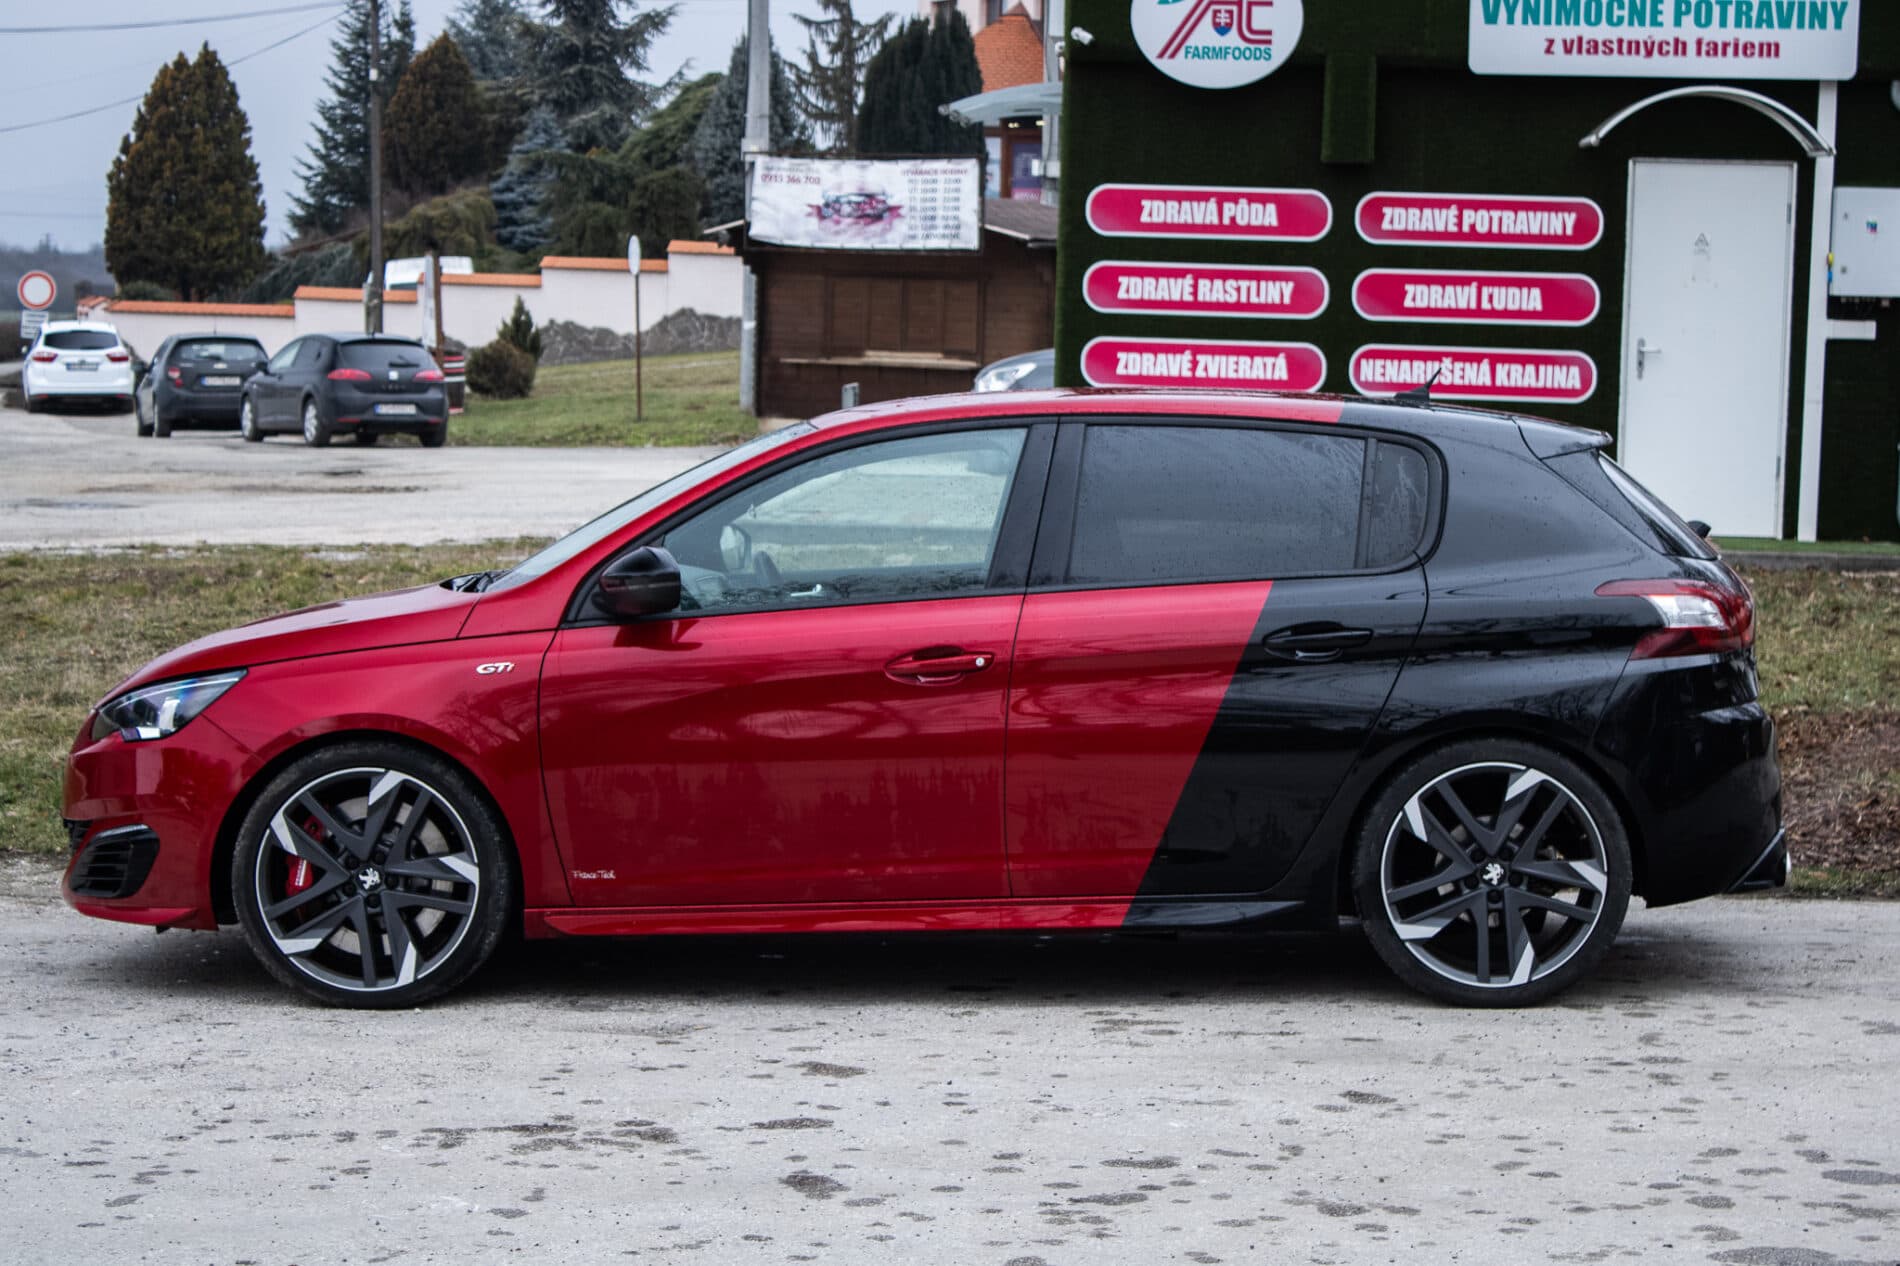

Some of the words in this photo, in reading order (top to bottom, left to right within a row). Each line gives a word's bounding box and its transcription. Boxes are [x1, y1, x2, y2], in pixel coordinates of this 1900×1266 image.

[1673, 0, 1848, 30] POTRAVINY
[1184, 45, 1273, 61] FARMFOODS
[1543, 38, 1555, 55] z
[1561, 35, 1687, 58] vlastných
[1695, 37, 1781, 59] fariem
[1140, 197, 1218, 225] ZDRAVÁ
[1222, 198, 1279, 227] PÔDA
[1381, 204, 1458, 232] ZDRAVÉ
[1462, 209, 1577, 237] POTRAVINY
[1117, 274, 1193, 302] ZDRAVÉ
[1197, 278, 1294, 305] RASTLINY
[1403, 281, 1478, 309] ZDRAVÍ
[1481, 285, 1543, 311] ĽUDIA
[1116, 350, 1192, 377] ZDRAVÉ
[1195, 352, 1288, 381] ZVIERATÁ
[1360, 357, 1491, 386] NENARUŠENÁ
[1495, 363, 1582, 389] KRAJINA
